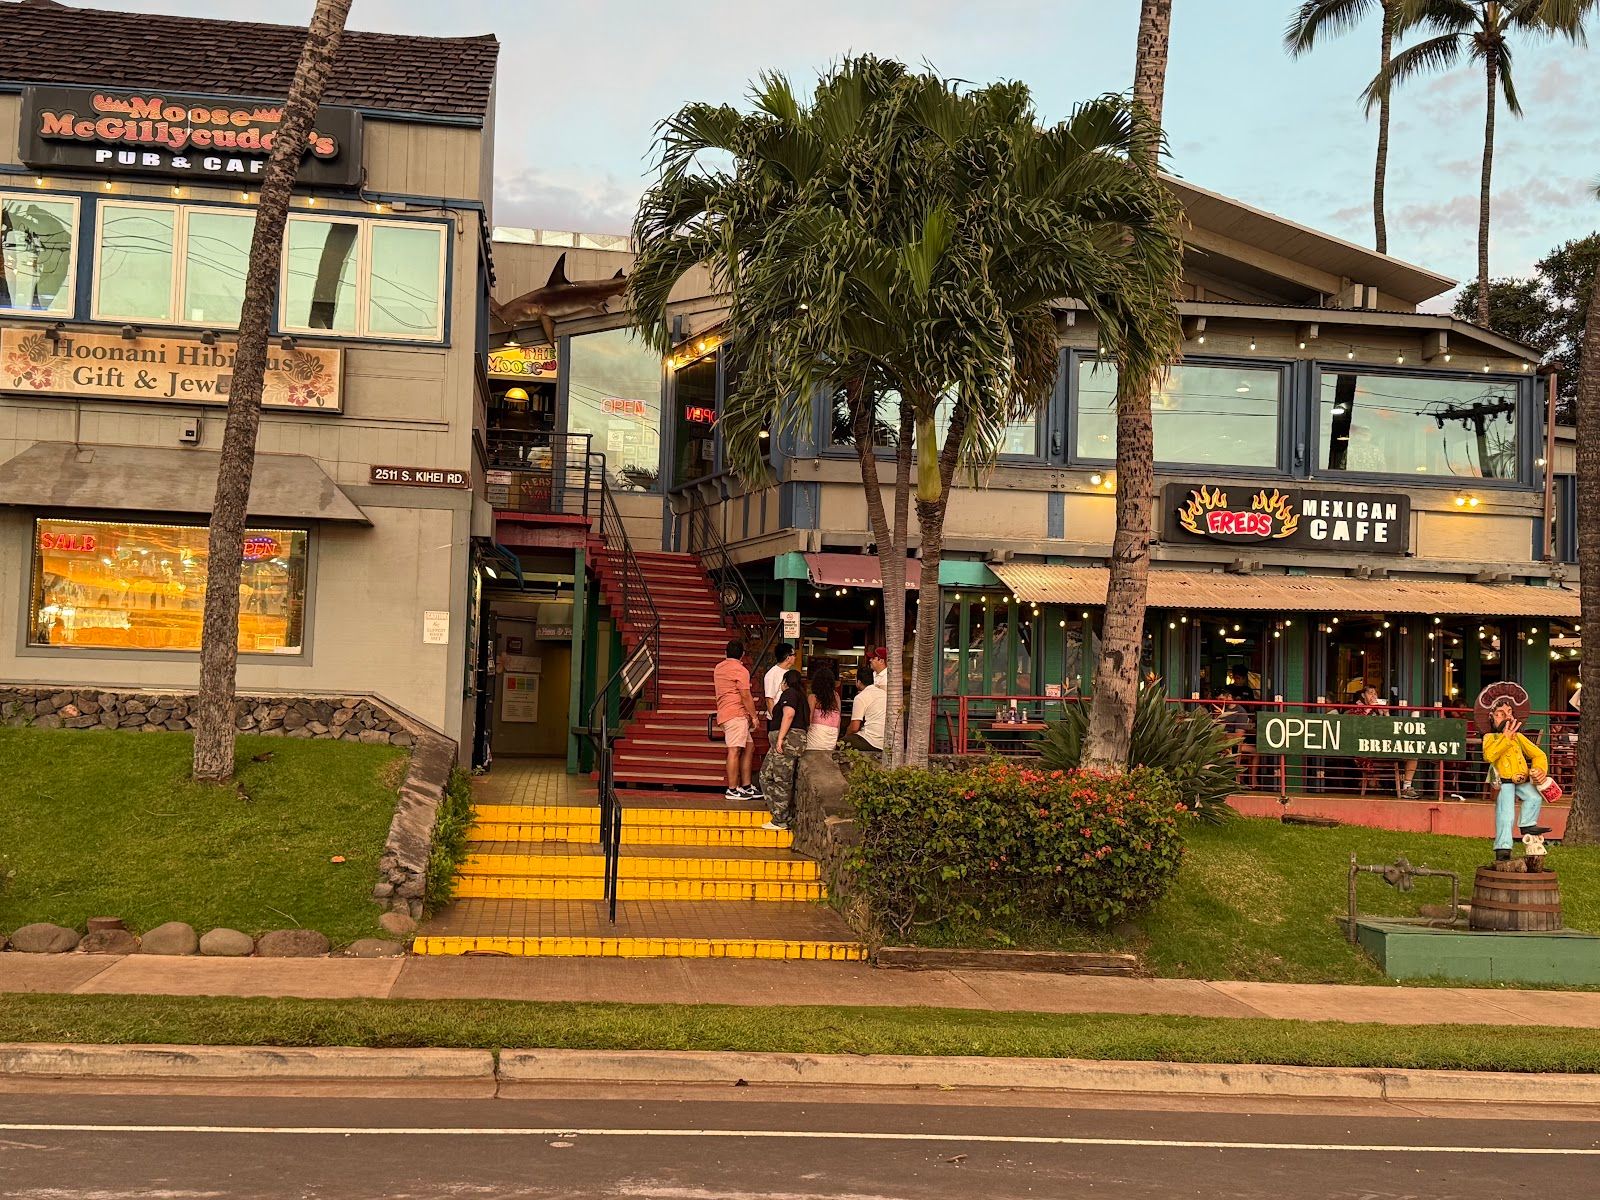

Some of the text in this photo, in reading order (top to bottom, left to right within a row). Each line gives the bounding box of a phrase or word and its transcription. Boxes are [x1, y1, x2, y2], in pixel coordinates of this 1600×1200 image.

[129, 96, 251, 127] Moose
[41, 112, 334, 155] McGillycudd's
[95, 149, 264, 174] PUB & CAF
[50, 338, 294, 372] Hoonani Hibius
[520, 346, 557, 360] THE
[73, 366, 125, 388] Gift
[134, 369, 158, 390] &
[602, 399, 645, 416] OPEN
[375, 468, 465, 484] 2511 S. KIHEI RD.
[1206, 499, 1397, 537] FRED'S MEXICAN
[40, 531, 97, 552] SALE
[1309, 519, 1389, 543] CAFE
[243, 542, 278, 557] PEN
[1265, 718, 1427, 750] OPEN FOR
[1358, 738, 1460, 755] BREAKFAST
